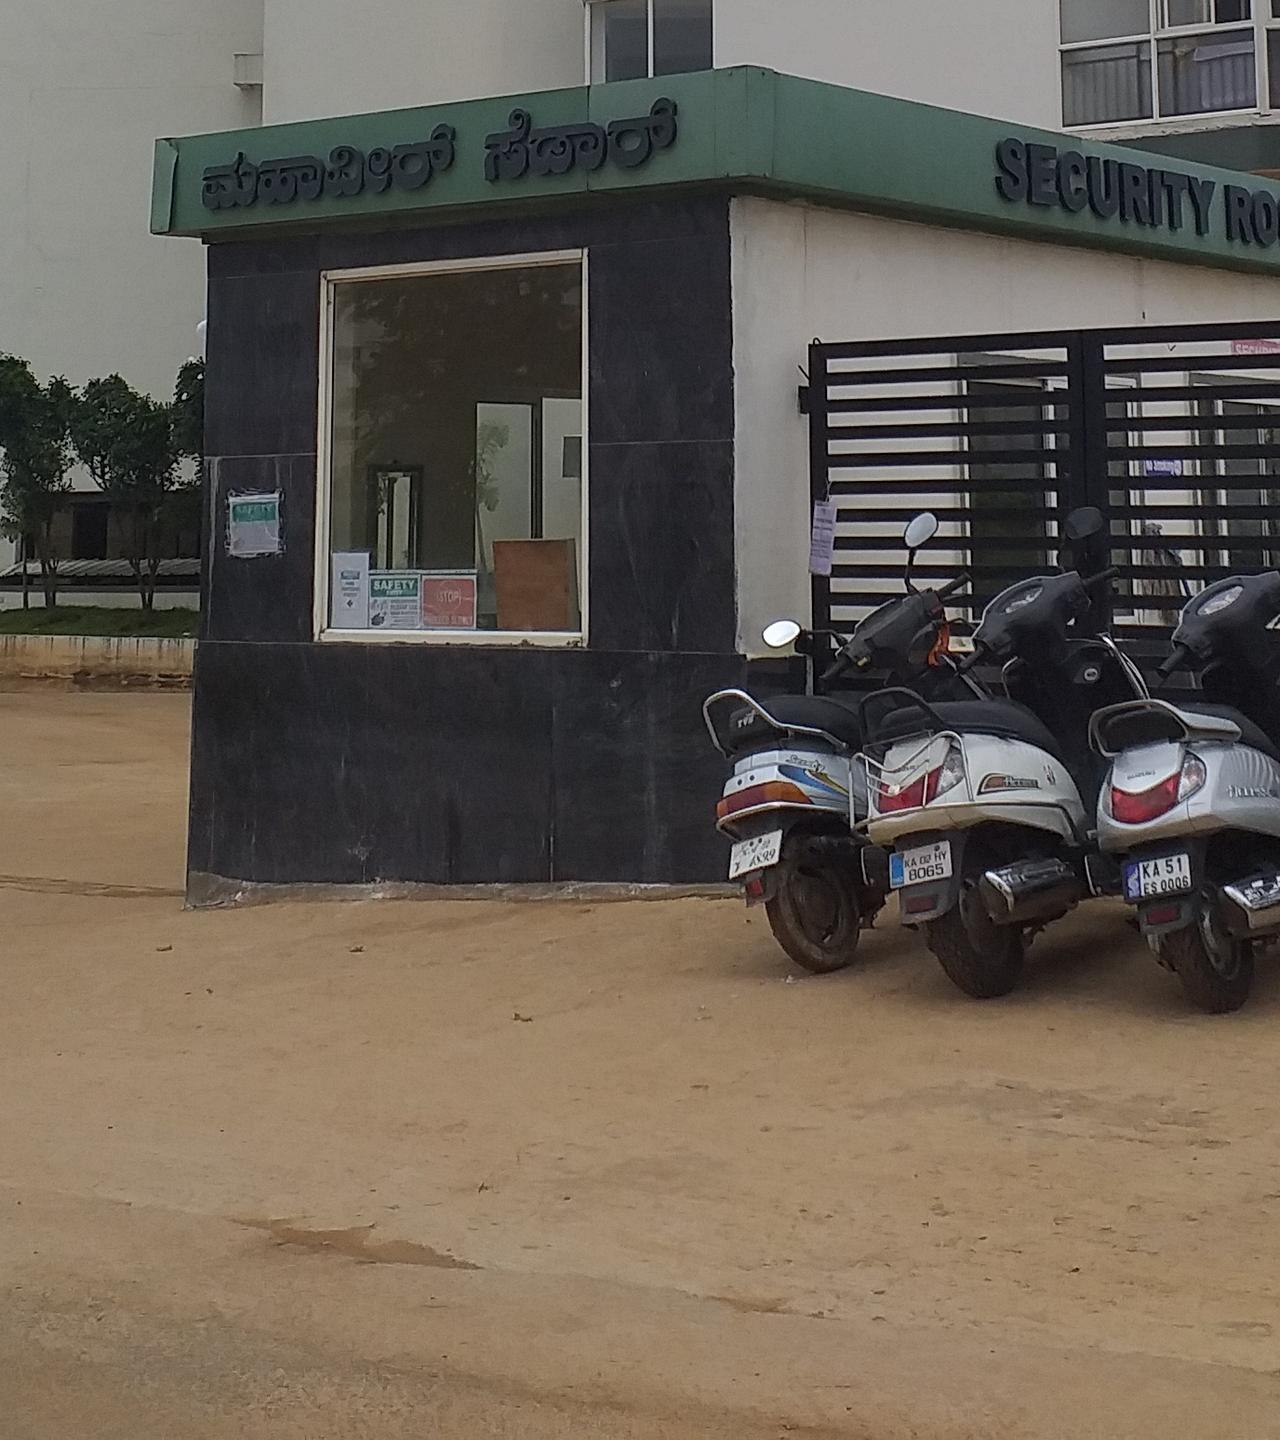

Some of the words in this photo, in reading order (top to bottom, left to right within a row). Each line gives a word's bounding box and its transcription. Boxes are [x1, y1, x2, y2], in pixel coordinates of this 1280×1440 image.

[202, 123, 456, 210] ಮಹಾವೀರ್
[995, 138, 1216, 236] SECURITY
[373, 580, 415, 590] SAFETY
[439, 591, 460, 603] STOP
[904, 857, 917, 868] KA
[1142, 861, 1160, 879] KA
[1166, 858, 1183, 875] 51
[908, 863, 945, 882] 8065
